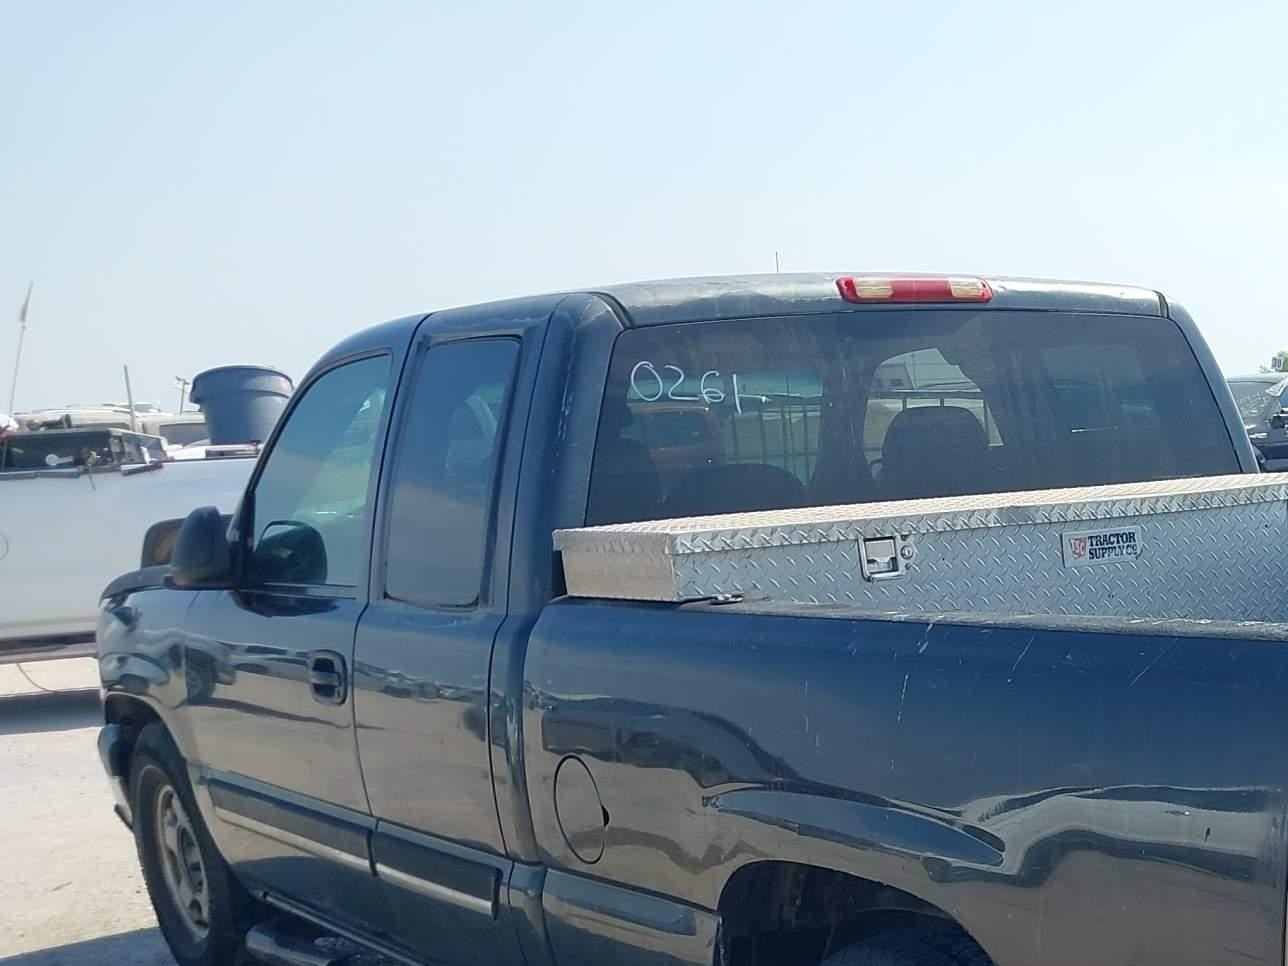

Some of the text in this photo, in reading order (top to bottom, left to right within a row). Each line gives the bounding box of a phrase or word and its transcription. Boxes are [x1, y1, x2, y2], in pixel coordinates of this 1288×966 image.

[630, 361, 741, 414] 0261
[1088, 532, 1137, 547] TRACTOR
[1089, 544, 1125, 560] SUPPLY
